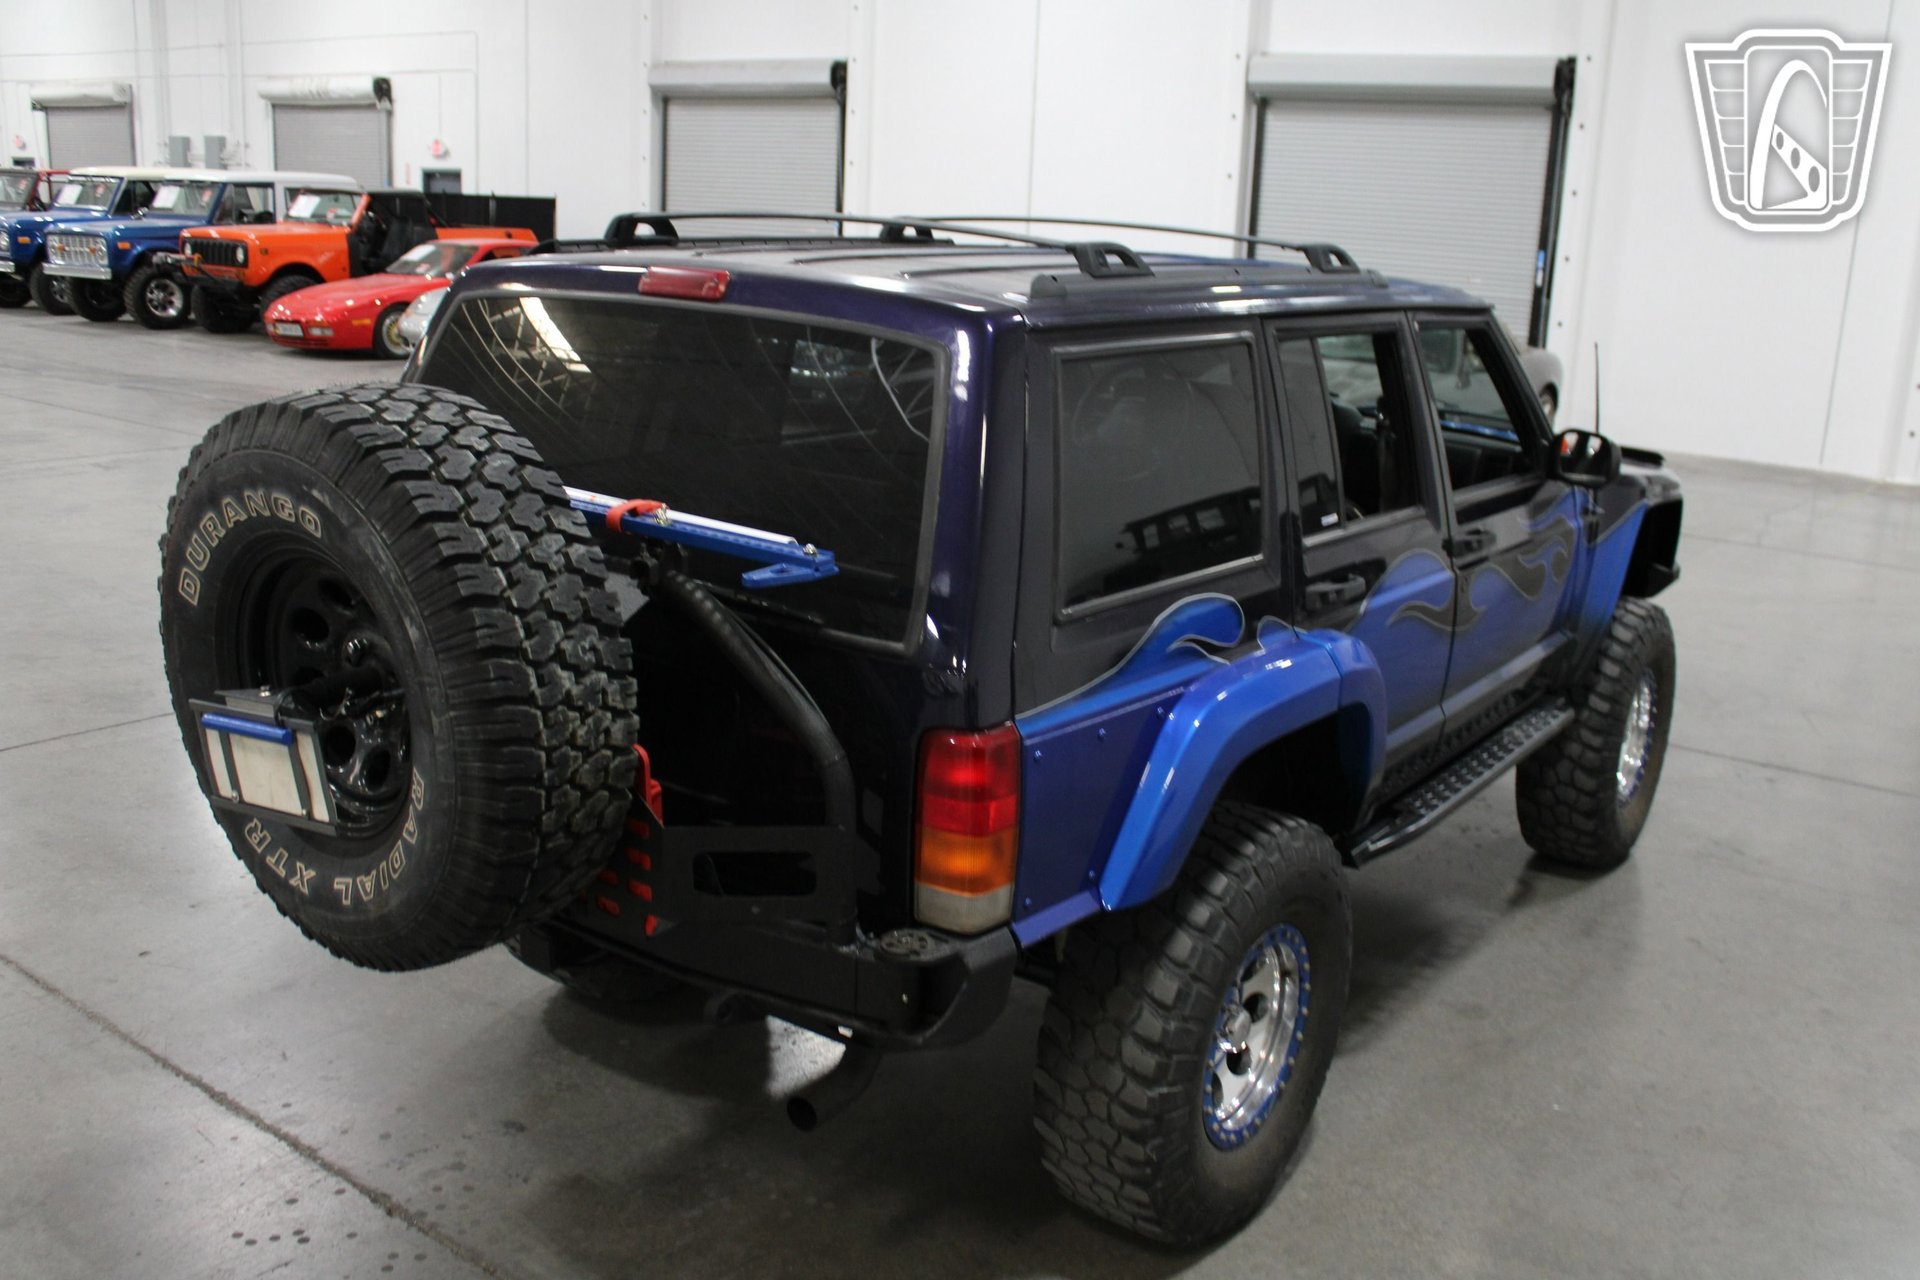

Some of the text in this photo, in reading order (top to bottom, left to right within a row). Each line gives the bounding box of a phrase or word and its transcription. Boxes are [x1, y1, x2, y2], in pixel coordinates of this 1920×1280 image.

[178, 490, 322, 606] DURANGO
[244, 767, 425, 905] RADIAL XTR
